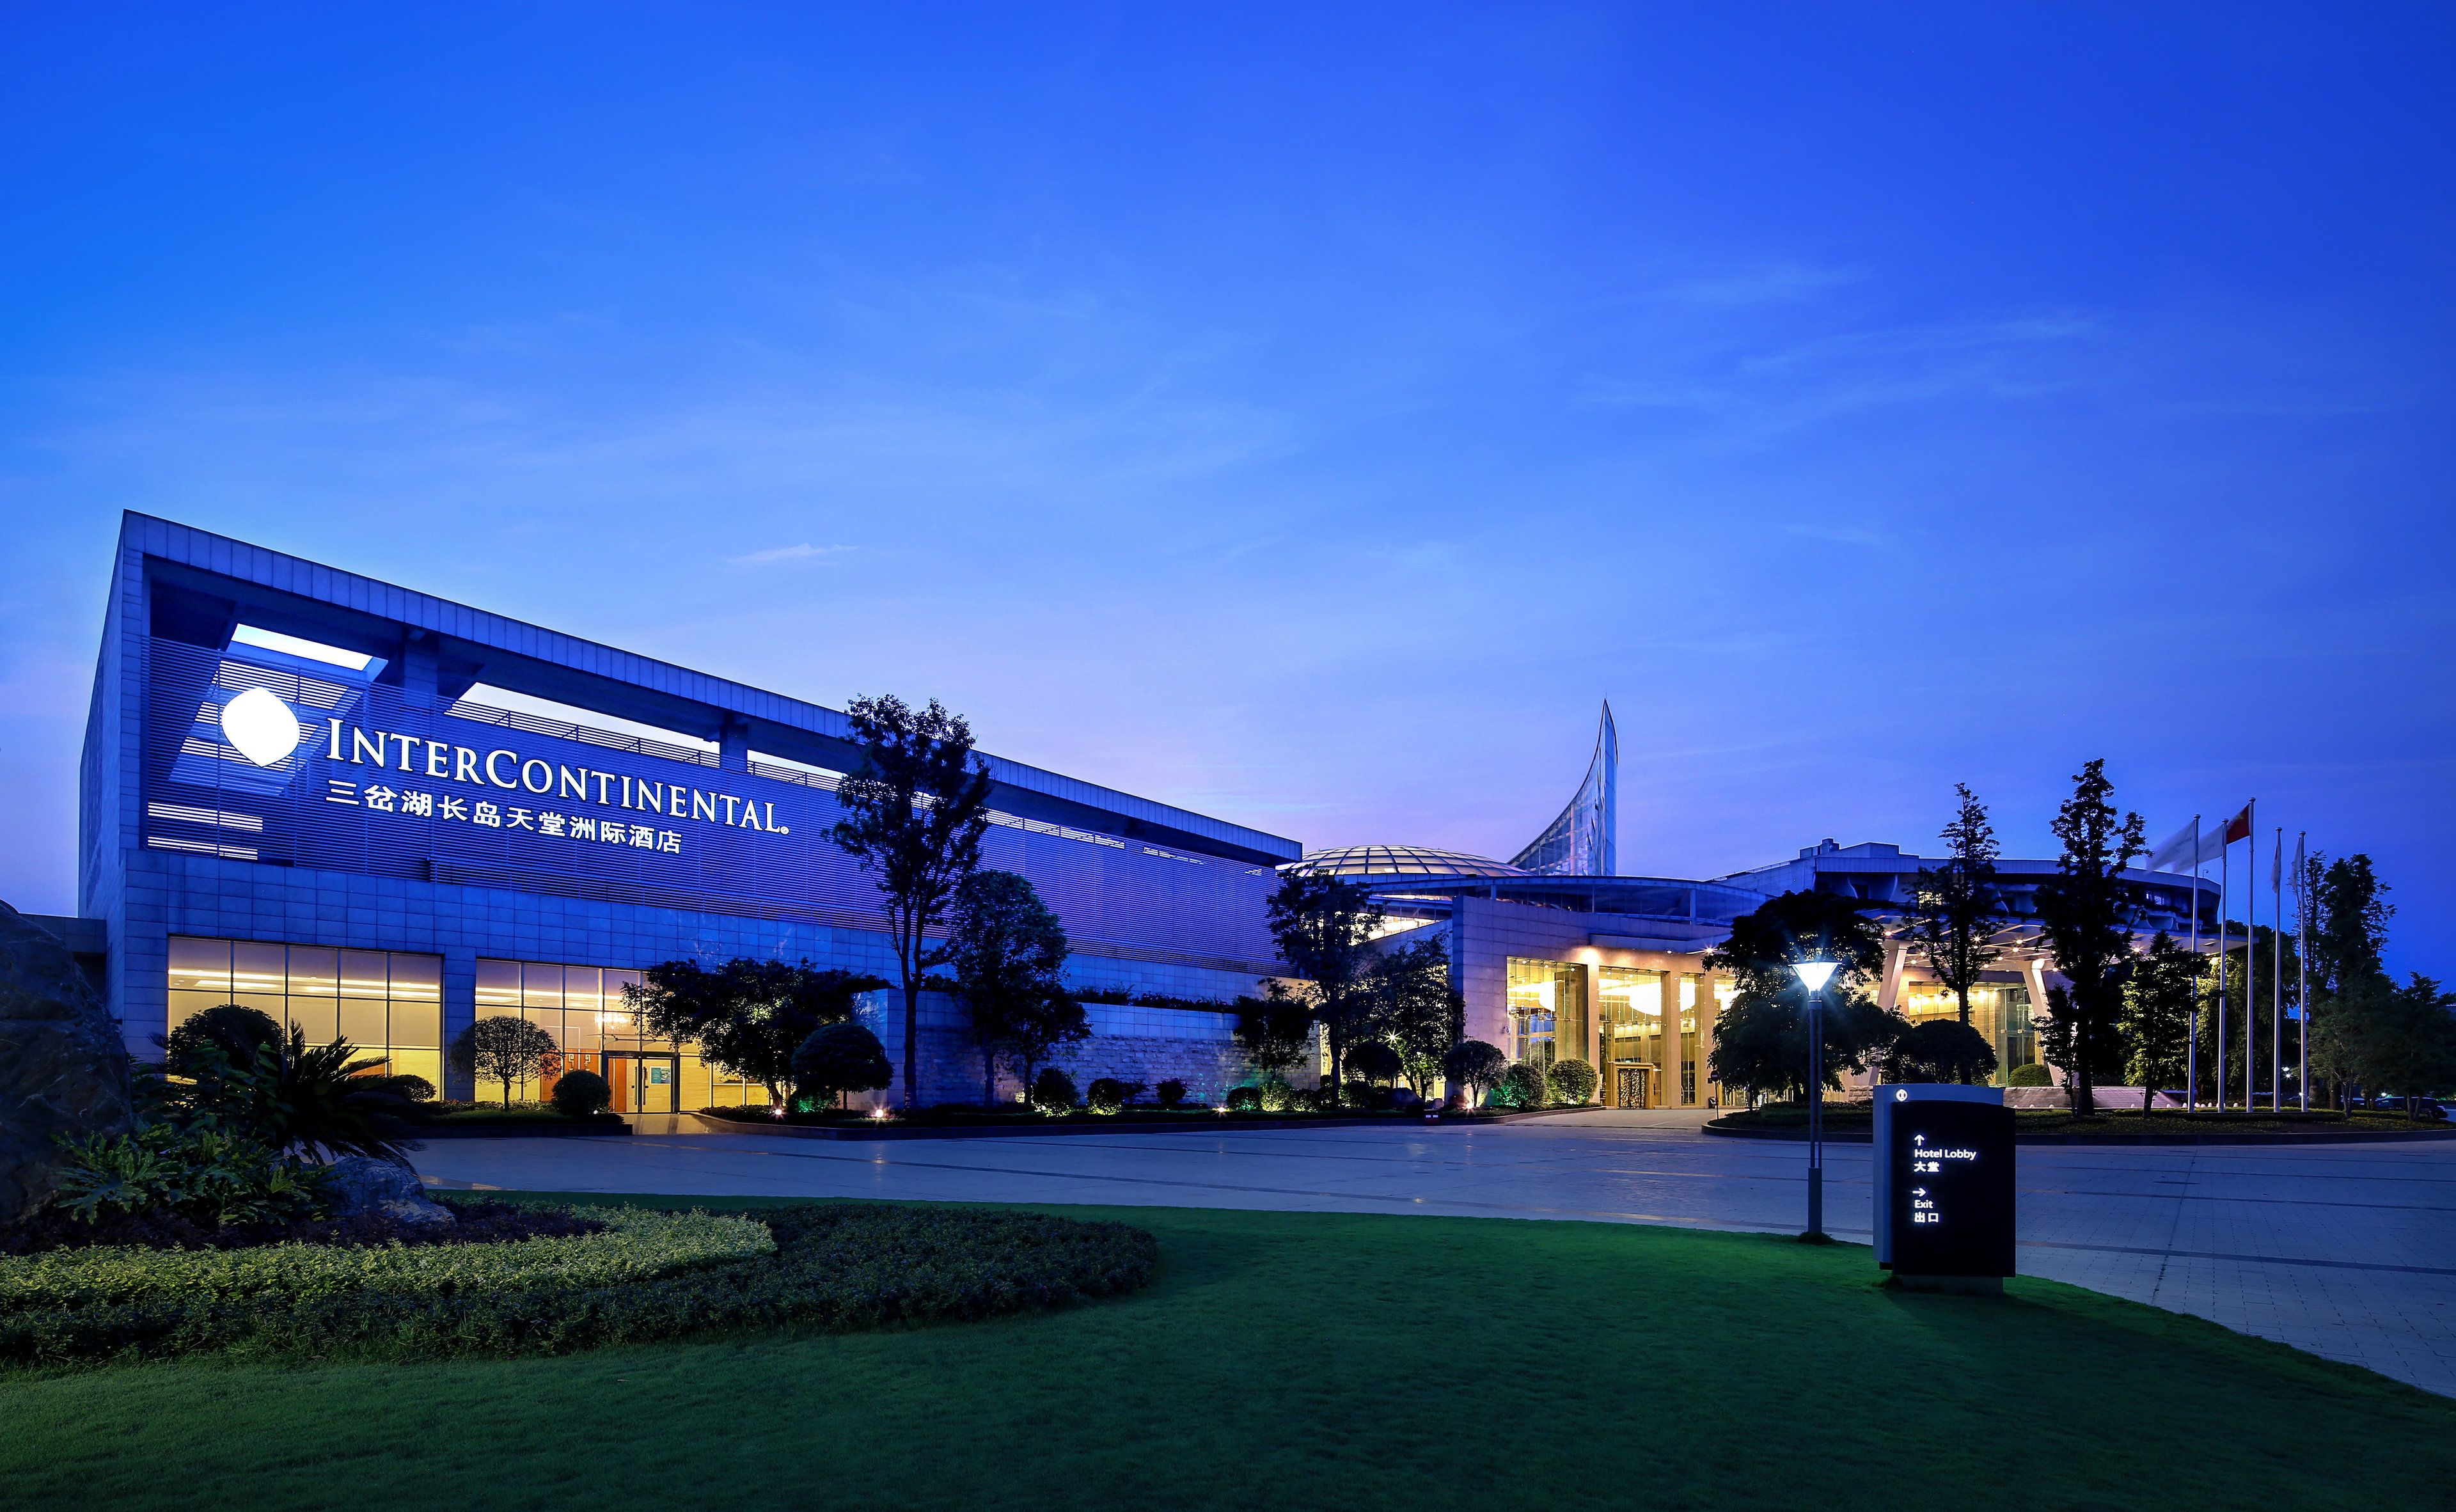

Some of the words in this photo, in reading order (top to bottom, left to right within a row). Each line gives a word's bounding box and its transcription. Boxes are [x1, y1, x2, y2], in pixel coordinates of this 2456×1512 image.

[326, 780, 682, 854] 三岔湖长岛天堂洲际酒店
[1914, 1149, 1942, 1158] Hotel
[1944, 1149, 1977, 1161] Lobby
[1914, 1161, 1940, 1172] 大堂
[1914, 1199, 1933, 1209] Exit
[1914, 1211, 1939, 1223] 出口
